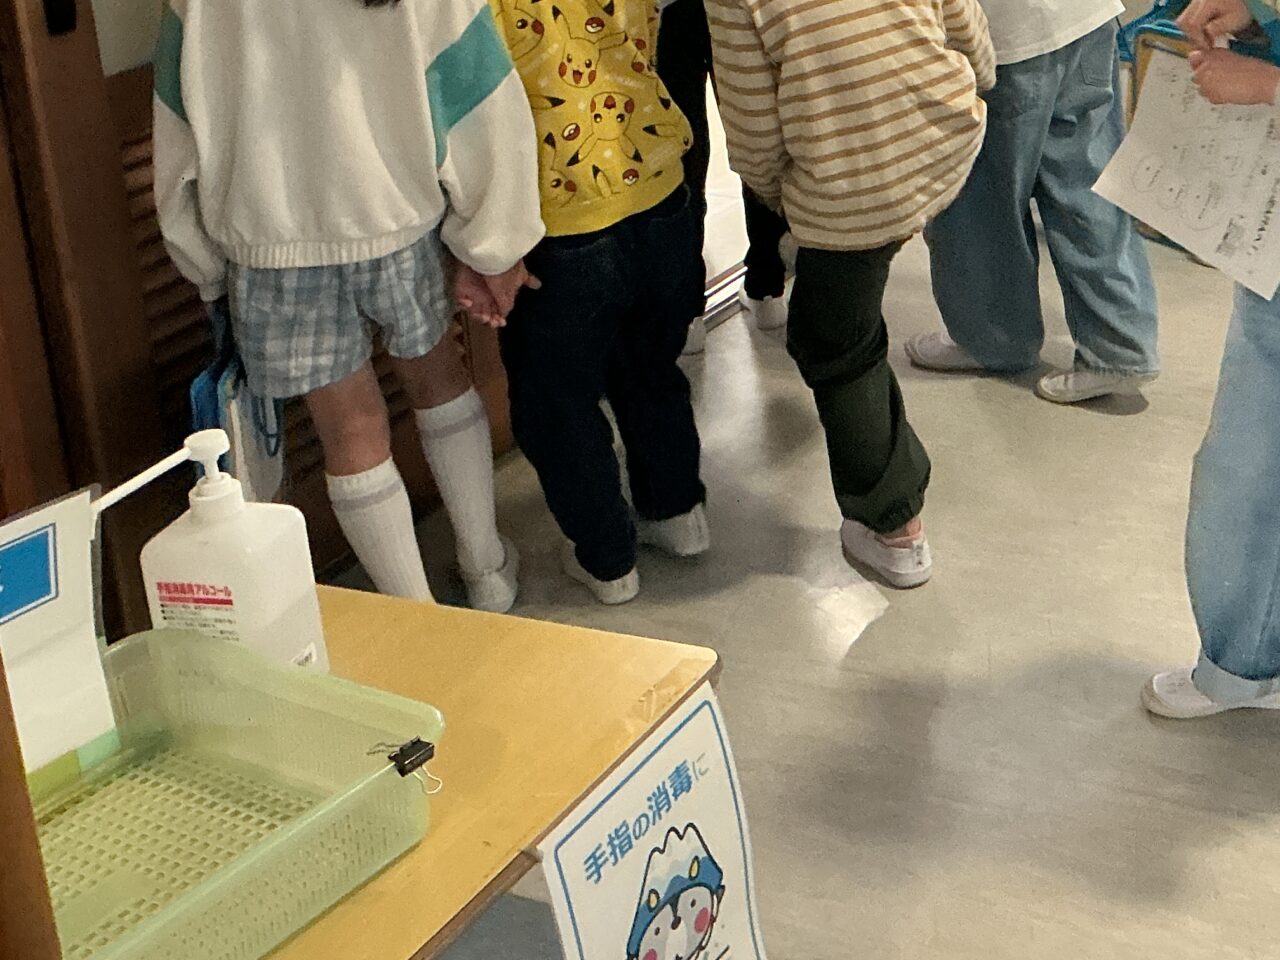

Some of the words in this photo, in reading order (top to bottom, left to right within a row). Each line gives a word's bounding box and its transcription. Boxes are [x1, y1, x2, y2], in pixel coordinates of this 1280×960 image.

[583, 752, 710, 885] 手指の消毒に
